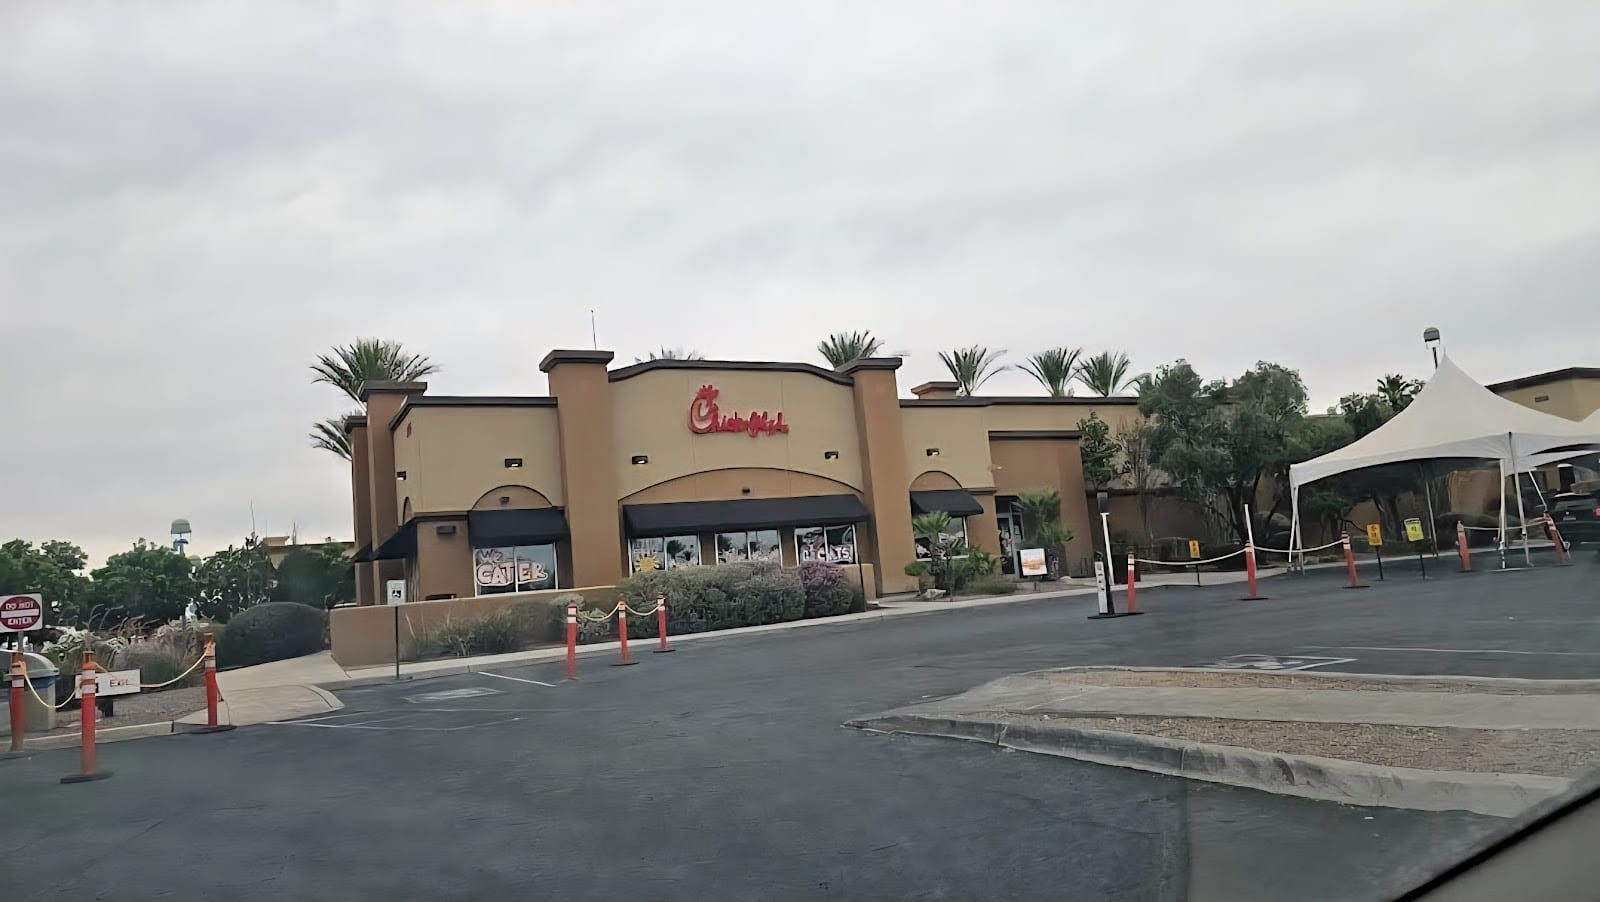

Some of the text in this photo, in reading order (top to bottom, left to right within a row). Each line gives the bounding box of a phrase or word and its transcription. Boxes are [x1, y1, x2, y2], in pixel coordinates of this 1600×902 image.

[477, 561, 548, 586] CATER
[5, 602, 17, 610] DO
[7, 616, 33, 625] ENTER
